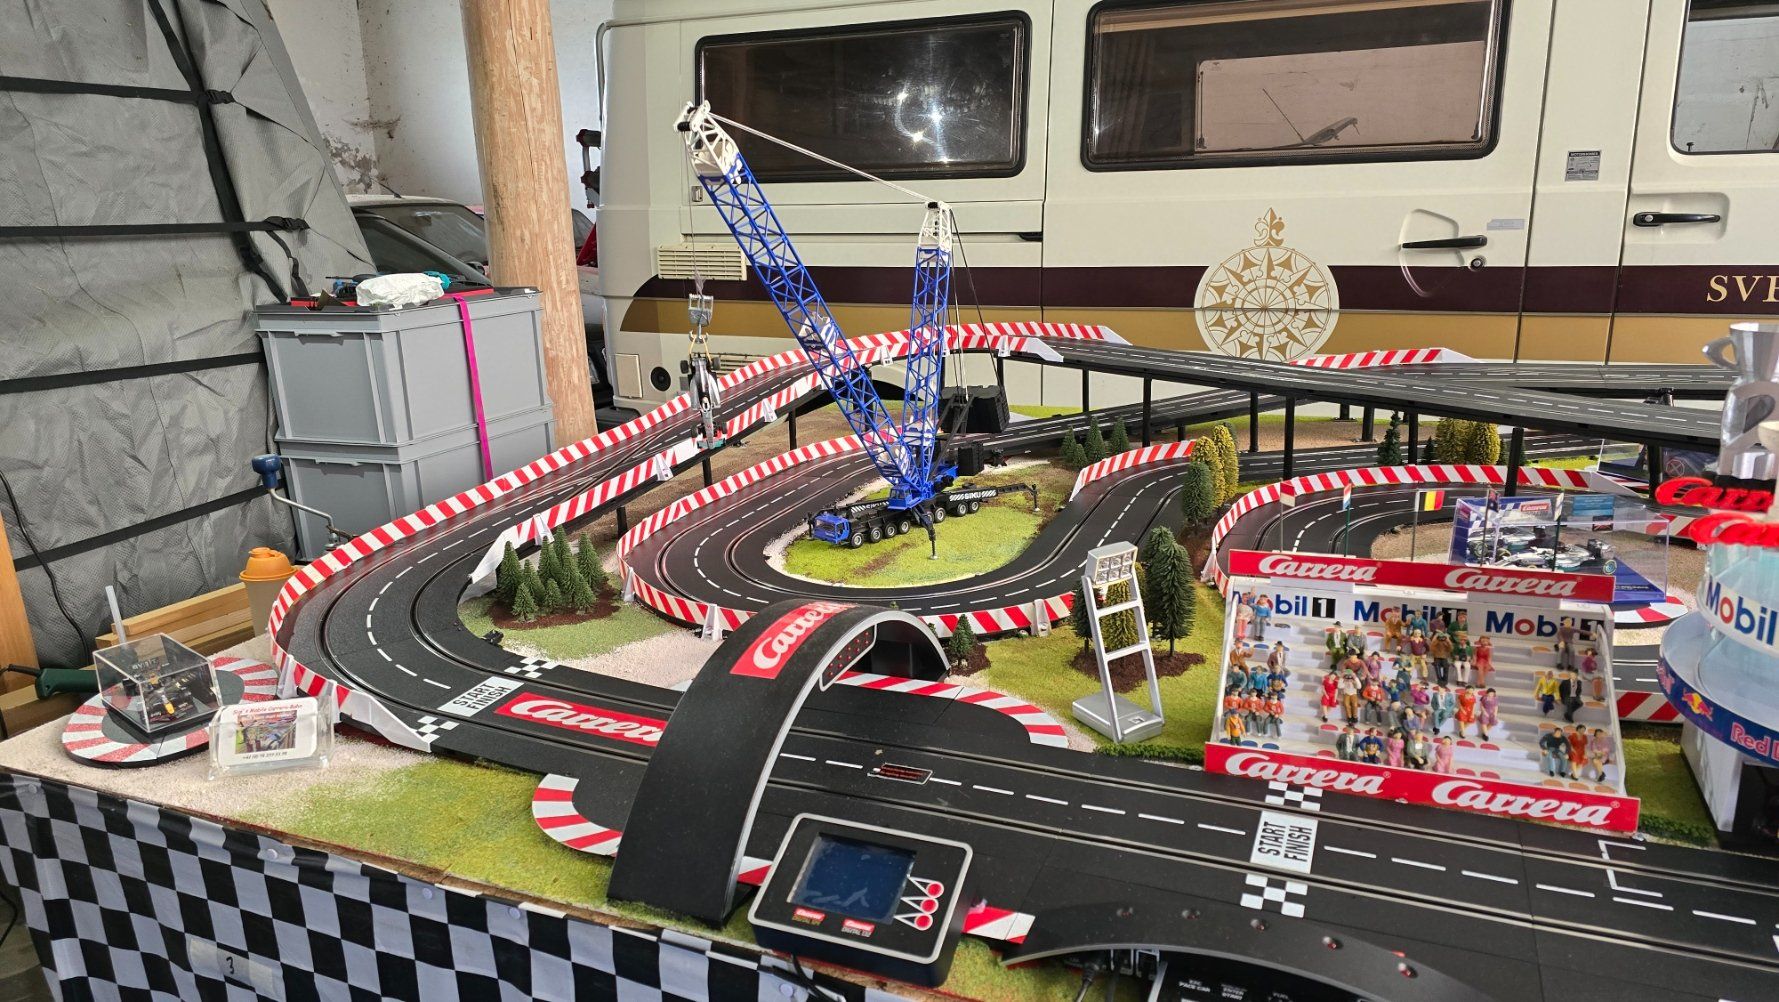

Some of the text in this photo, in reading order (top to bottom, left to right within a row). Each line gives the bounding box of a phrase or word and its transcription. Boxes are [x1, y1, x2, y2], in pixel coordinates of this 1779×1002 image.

[1258, 555, 1377, 583] Carrera
[1444, 567, 1577, 597] Carrera
[1706, 577, 1778, 647] Mobil
[753, 600, 858, 670] Carrera
[452, 684, 495, 706] START
[466, 686, 512, 710] FINISH
[510, 699, 664, 742] Carrera
[1730, 721, 1770, 760] Red
[1224, 752, 1387, 796] Carrera
[1431, 778, 1614, 827] Carrera
[1258, 821, 1286, 856] START
[1284, 825, 1312, 862] FINISH
